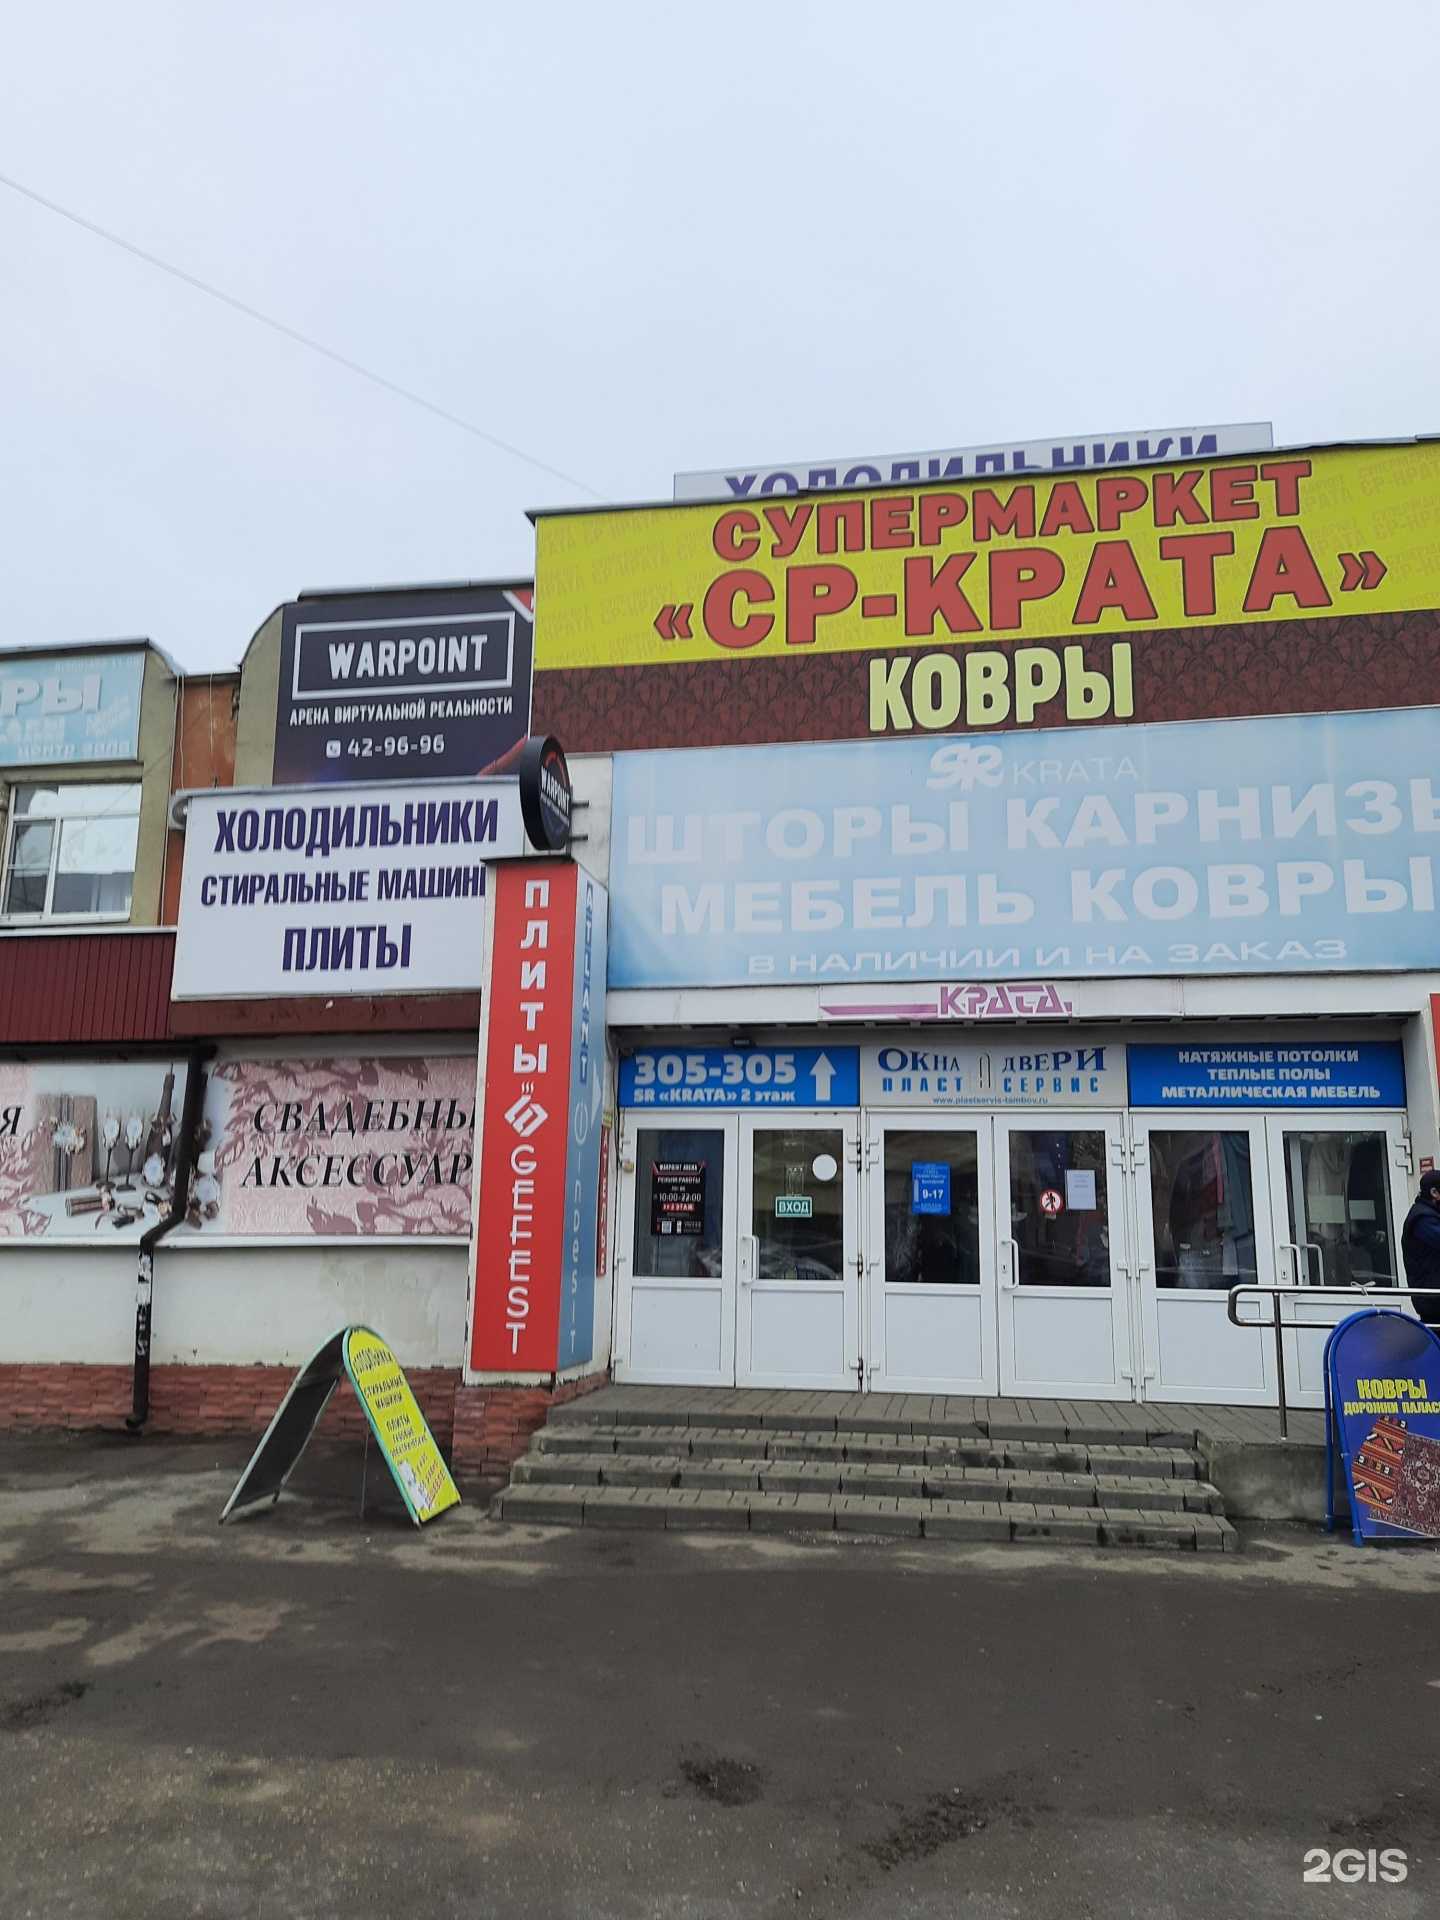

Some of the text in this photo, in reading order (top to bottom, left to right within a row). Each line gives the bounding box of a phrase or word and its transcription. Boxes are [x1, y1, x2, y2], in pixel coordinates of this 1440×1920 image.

[712, 459, 1312, 562] СУПЕРМАРКЕТ
[653, 526, 1388, 649] «СР-КРАТА»
[328, 634, 488, 680] WARPOINT
[868, 642, 1135, 733] КОВРЫ
[289, 696, 513, 726] АРЕНА ВИРТУАЛЬНОЙ РЕАЛЬНОСТИ
[347, 734, 446, 757] 42-96-96
[1012, 756, 1139, 786] KRATA
[541, 765, 570, 816] WARPOINT
[213, 799, 498, 857] ХОЛОДИЛЬНИКИ
[627, 801, 969, 865] ШТОРЫ
[200, 870, 370, 906] СТИРАЛЬНЫЕ
[660, 856, 1435, 935] МЕБЕЛЬ КОВРЫ
[282, 923, 412, 971] ПЛИТЫ
[748, 939, 1347, 976] В НАЛИЧИИ И НА ЗАКАЗ
[513, 879, 550, 1073] ПЛИТЫ
[634, 1054, 797, 1085] 305-305
[1178, 1049, 1359, 1063] НАТЯЖНЫЕ ПОТОЛКИ
[882, 1077, 963, 1092] ПЛАСТ
[1003, 1076, 1099, 1093] СЕРВИС
[1207, 1067, 1330, 1081] ТЕПЛЫЕ ПОЛЫ
[634, 1088, 656, 1103] SR
[741, 1088, 750, 1103] 2
[754, 1090, 795, 1103] этаж
[1162, 1085, 1381, 1099] МЕТАЛЛИЧЕСКАЯ МЕБЕЛЬ
[778, 1201, 809, 1213] ВХОД
[1356, 1379, 1427, 1399] КОВРЫ
